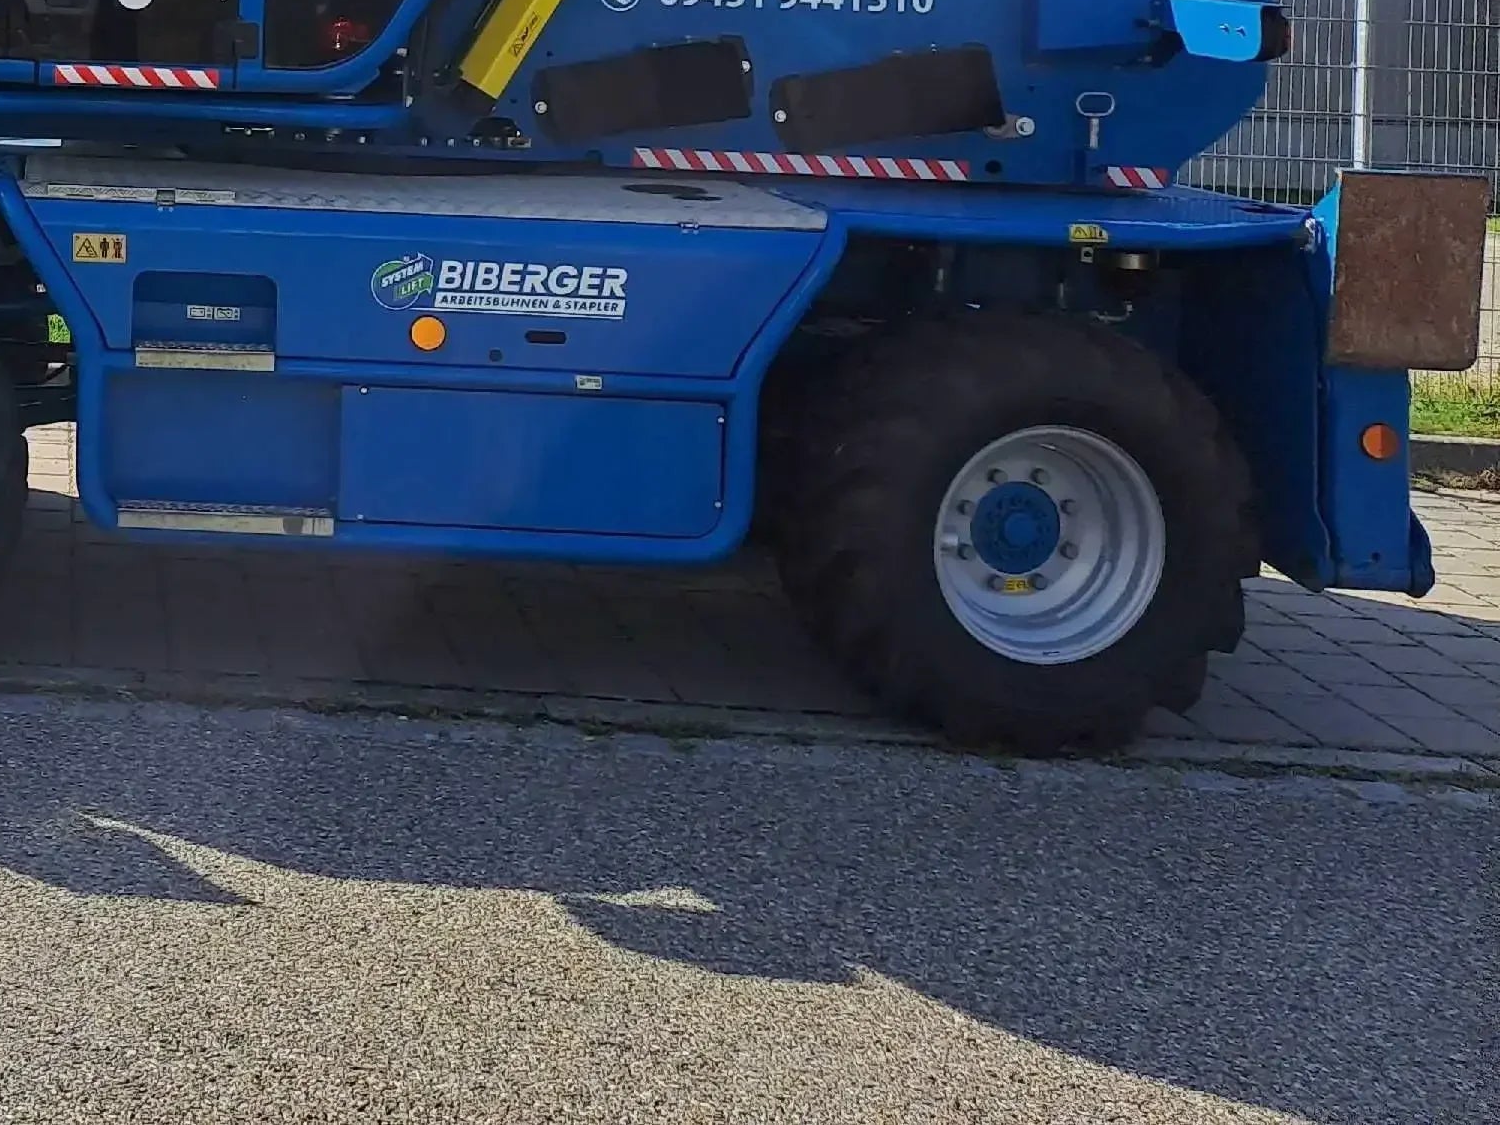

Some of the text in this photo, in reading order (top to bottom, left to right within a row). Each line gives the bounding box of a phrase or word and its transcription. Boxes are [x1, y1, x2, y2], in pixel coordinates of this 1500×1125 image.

[380, 261, 425, 289] SYSTEM
[401, 278, 426, 294] LIFT
[437, 259, 629, 297] BIBERGER
[552, 299, 562, 310] &
[564, 300, 619, 312] STAPLER
